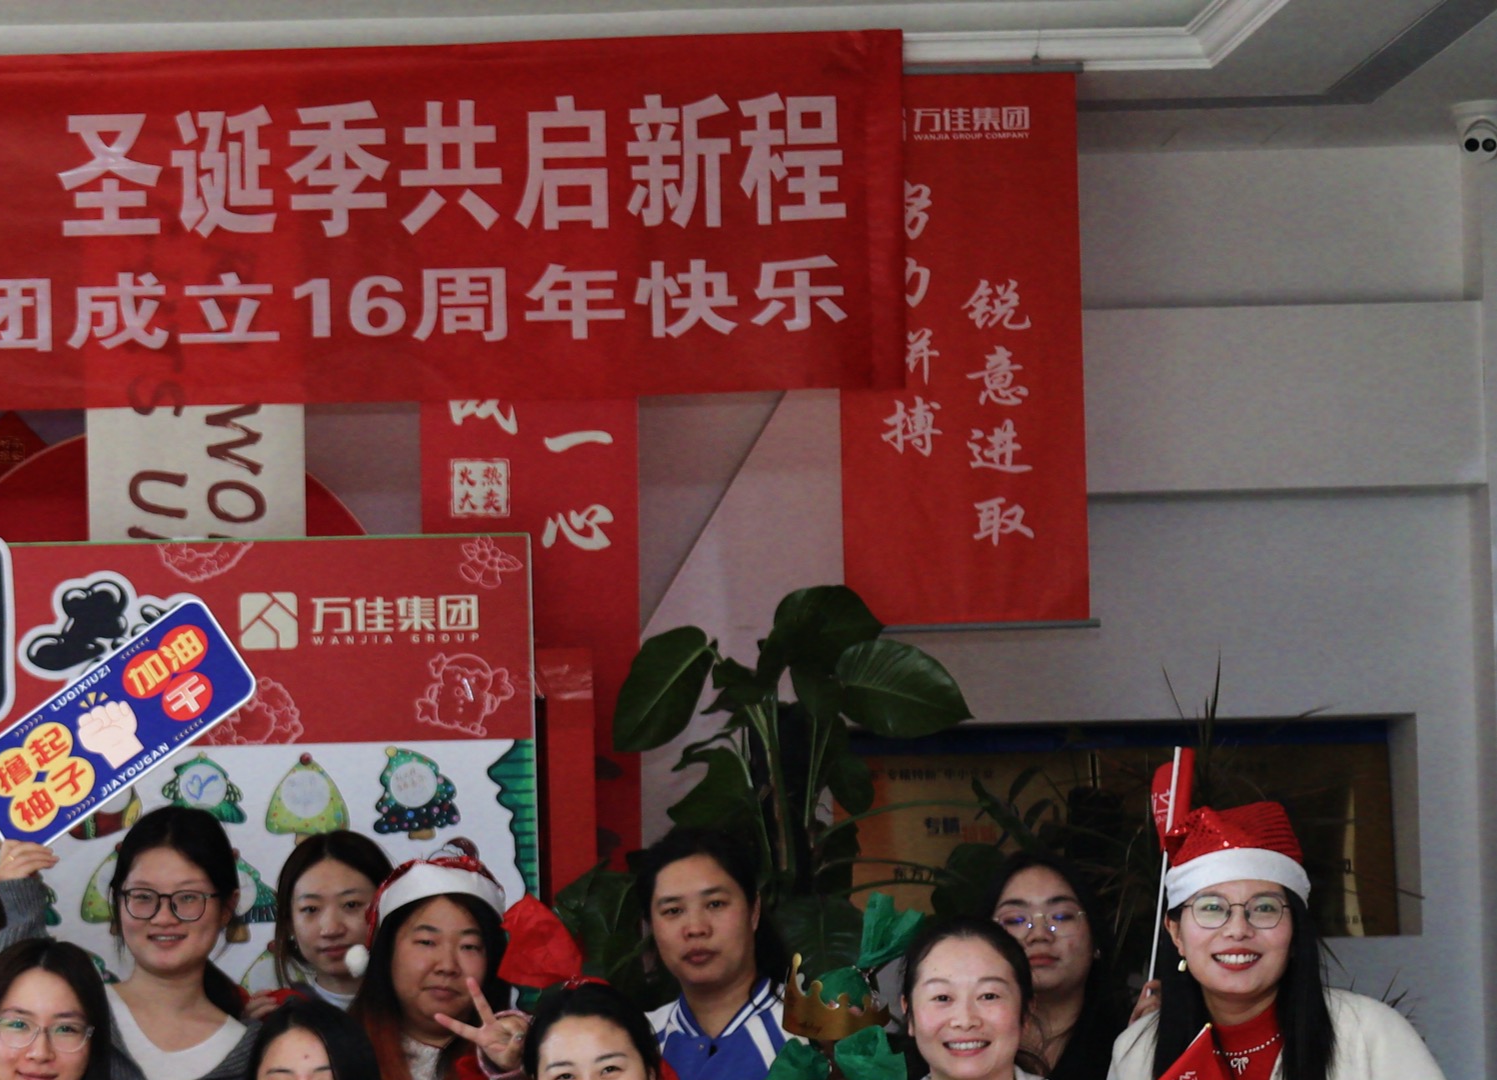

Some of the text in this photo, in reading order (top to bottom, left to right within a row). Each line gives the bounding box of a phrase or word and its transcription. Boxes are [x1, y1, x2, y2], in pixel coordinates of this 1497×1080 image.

[913, 106, 1030, 134] 万佳集团
[913, 131, 1030, 141] WANJIA GROUP COMPANY
[58, 92, 847, 238] 圣诞季共启新程
[961, 278, 1035, 546] 锐意进取
[312, 594, 480, 634] 万佳集团
[127, 629, 205, 696] 加油
[313, 632, 480, 646] WANJIA GROUP
[165, 674, 206, 713] 干
[101, 741, 170, 797] JIAYOUGAN
[14, 761, 87, 827] 袖子
